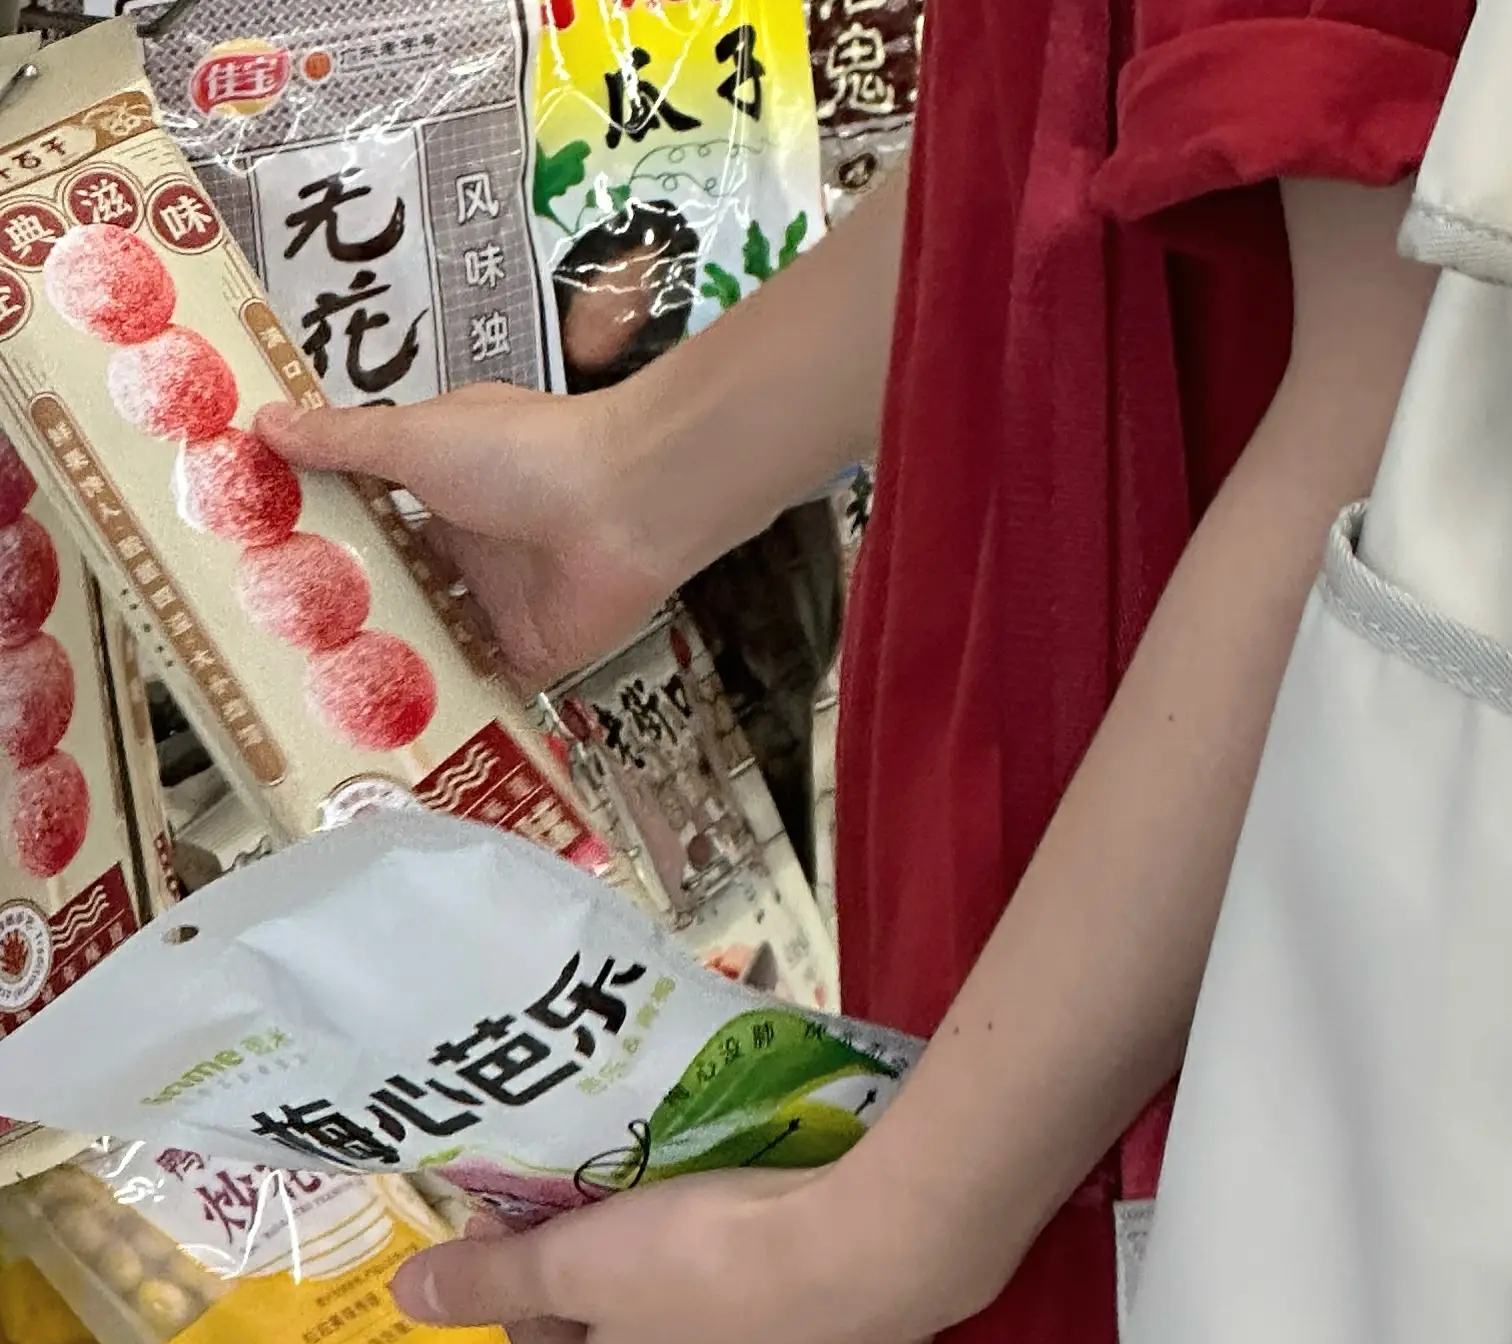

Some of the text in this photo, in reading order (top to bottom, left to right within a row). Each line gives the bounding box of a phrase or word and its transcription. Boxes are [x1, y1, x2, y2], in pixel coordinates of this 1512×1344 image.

[604, 25, 763, 149] 瓜子
[283, 168, 430, 406] 无花
[454, 167, 512, 386] 风味独
[251, 950, 646, 1169] 梅心芭乐
